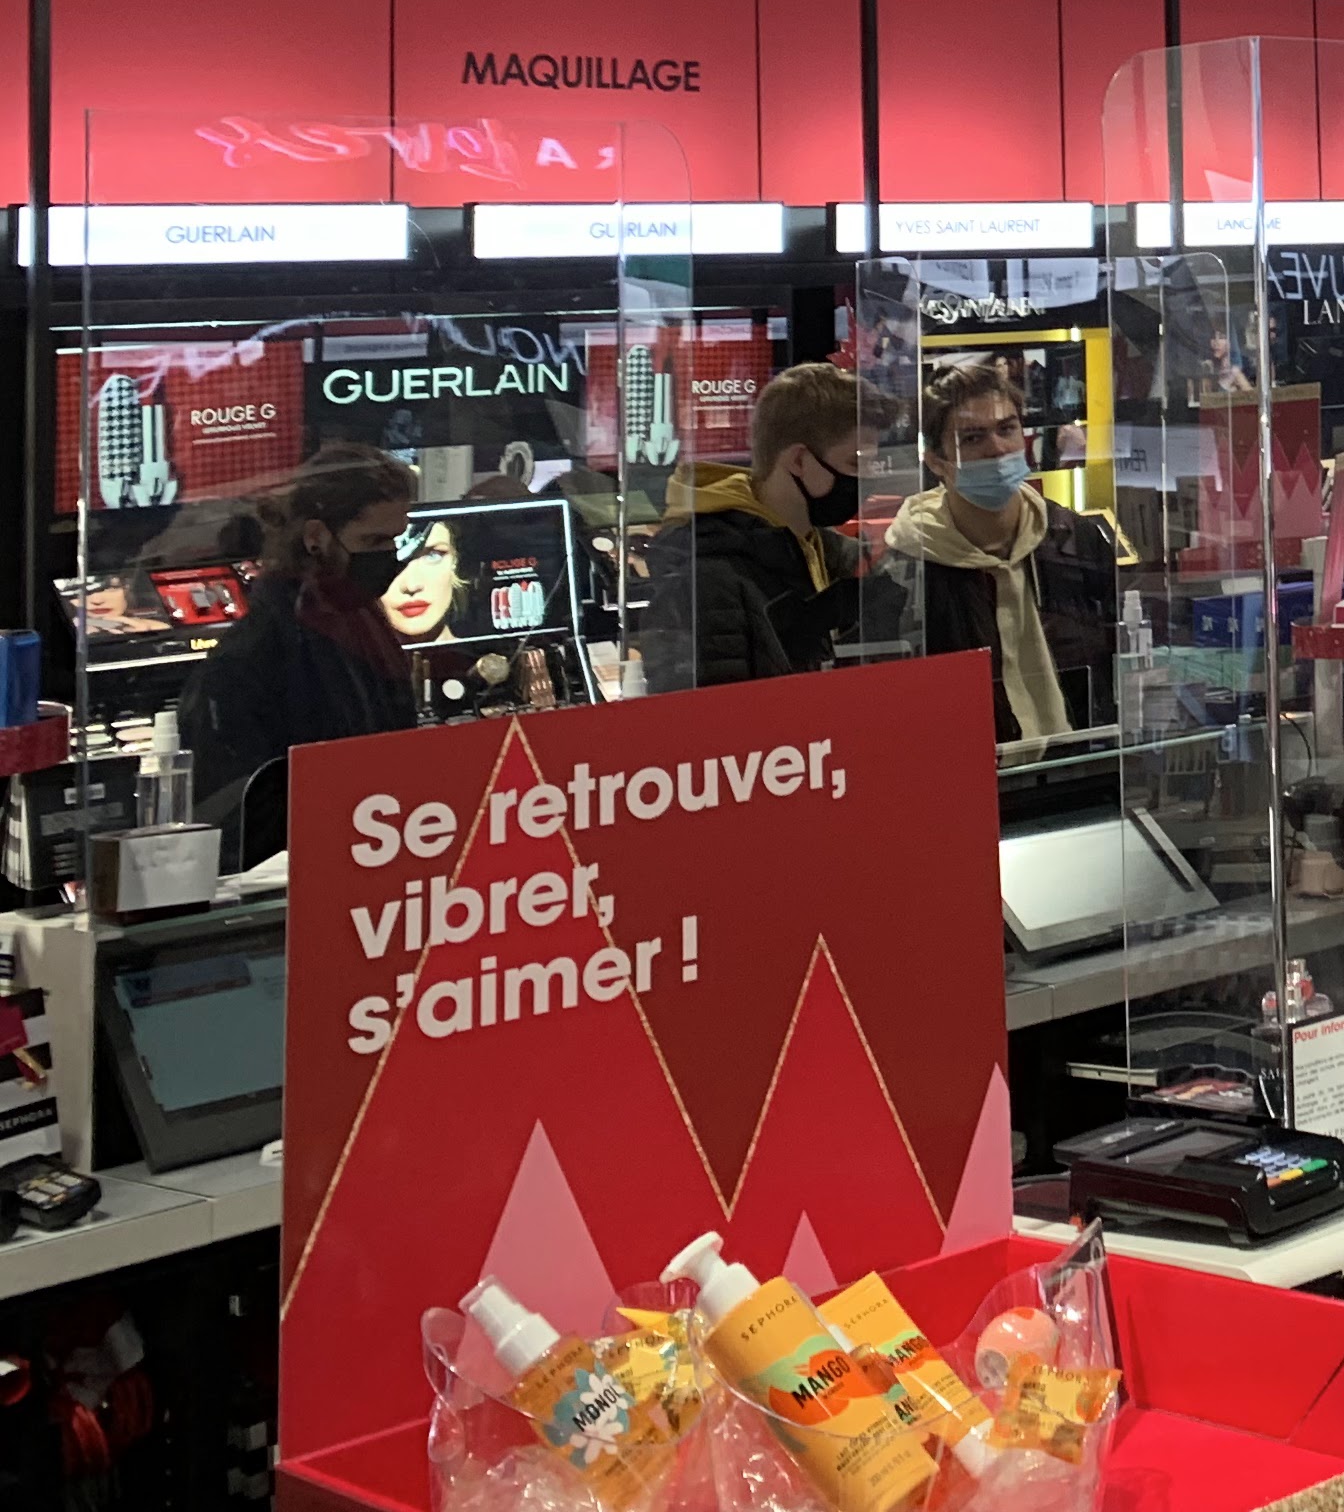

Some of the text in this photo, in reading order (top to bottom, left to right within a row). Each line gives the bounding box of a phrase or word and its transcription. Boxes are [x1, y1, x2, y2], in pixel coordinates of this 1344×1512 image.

[462, 51, 701, 92] MAQUILLAGE
[165, 224, 276, 244] GUERLAIN
[896, 218, 1041, 234] YVES SAINT LAURENT
[322, 362, 570, 405] GUERLAIN
[692, 379, 757, 395] ROUGE G
[190, 402, 278, 426] ROUGE G
[350, 738, 847, 868] Se retrouver,
[350, 861, 615, 961] vibrer,
[347, 936, 662, 1056] s'aimer
[1294, 1028, 1318, 1044] Pour
[791, 1355, 851, 1409] MANGO
